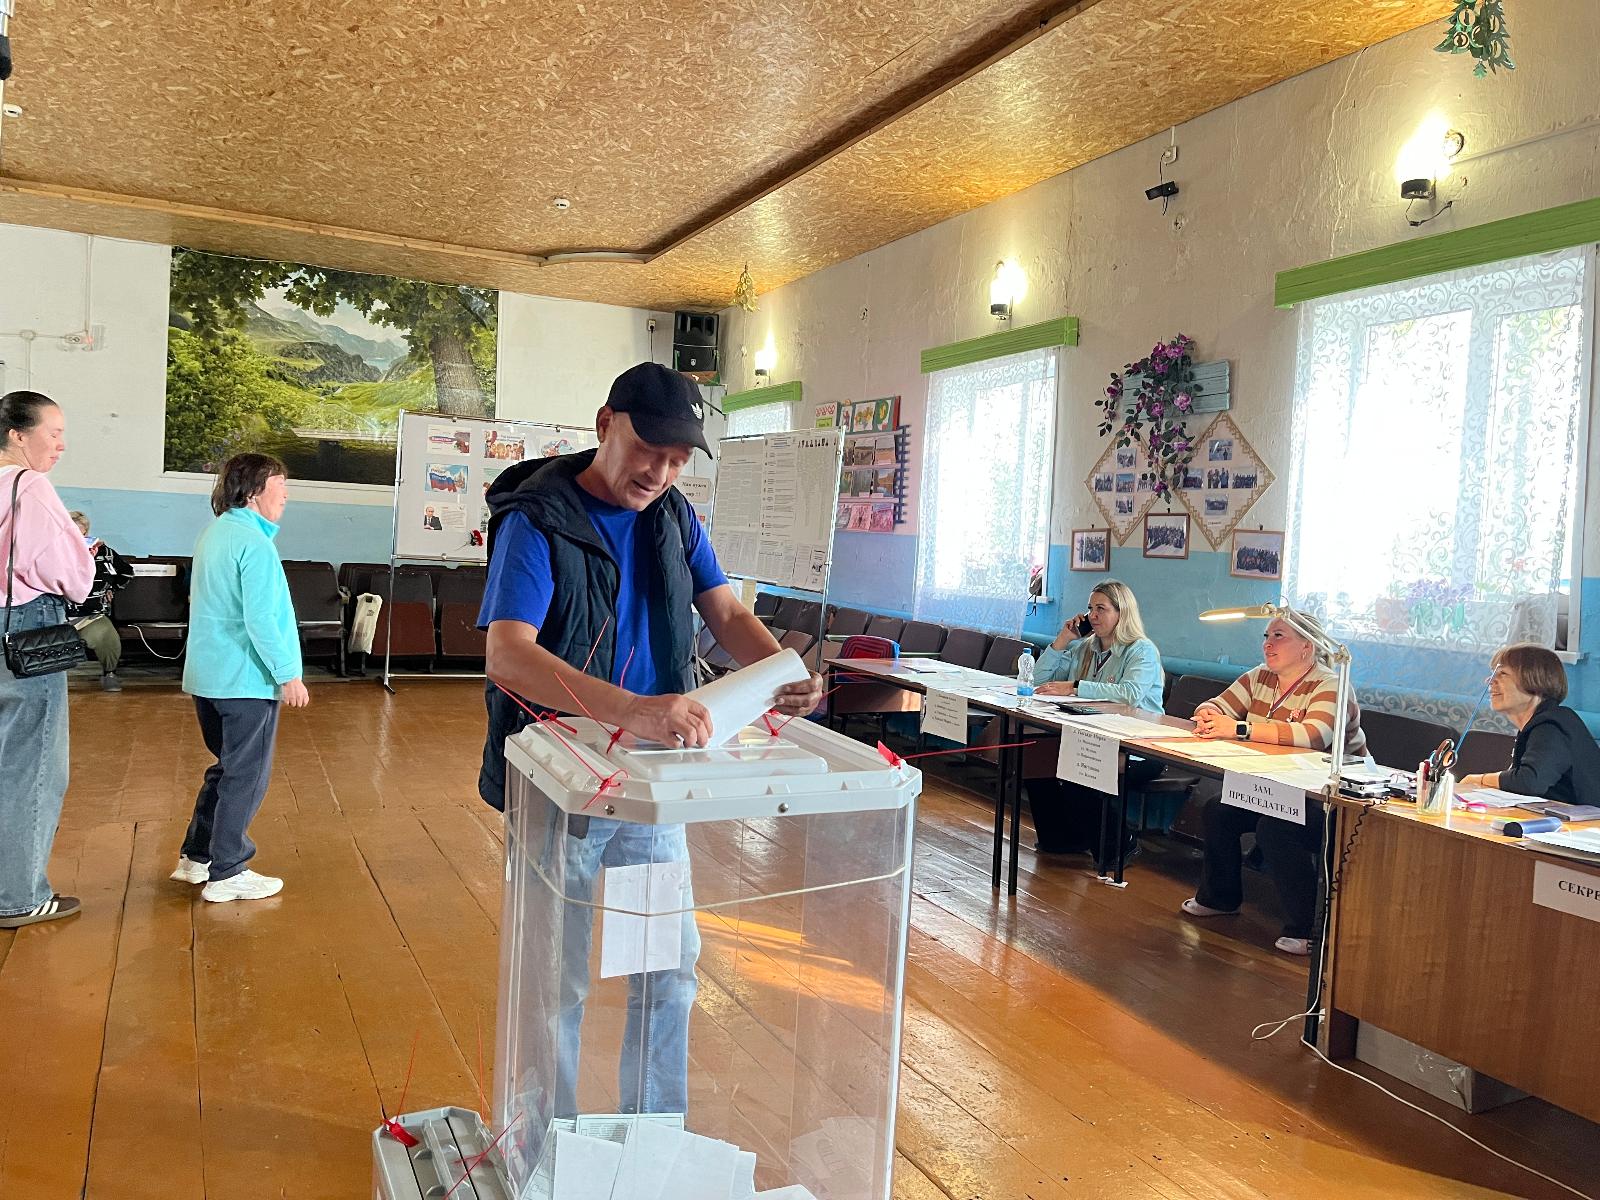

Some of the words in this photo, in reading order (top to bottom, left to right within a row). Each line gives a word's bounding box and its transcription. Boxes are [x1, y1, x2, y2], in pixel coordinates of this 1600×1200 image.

[1253, 783, 1273, 796] ЗАМ.
[1229, 790, 1299, 817] ПРЕДСЕДАТЕЛЯ
[1558, 880, 1600, 901] СЕКРЕ
